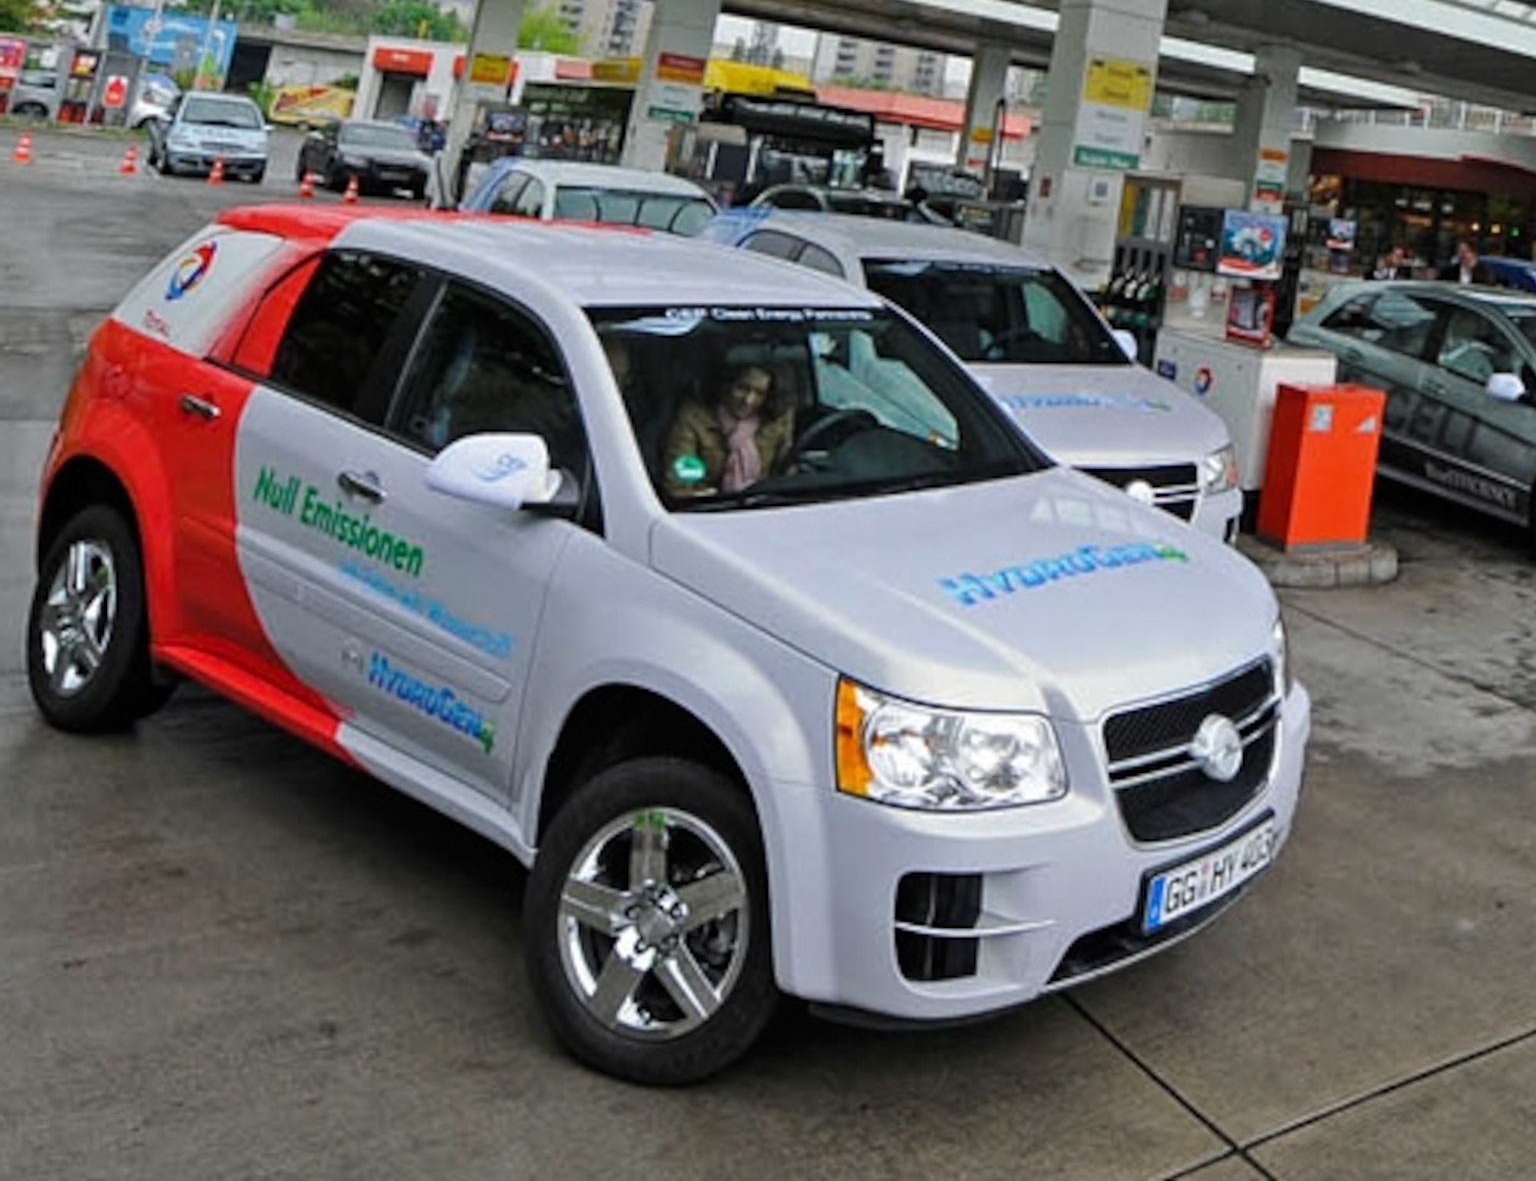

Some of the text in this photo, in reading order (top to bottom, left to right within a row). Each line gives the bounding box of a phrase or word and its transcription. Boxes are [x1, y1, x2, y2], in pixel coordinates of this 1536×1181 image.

[253, 467, 425, 578] Null Emissionen
[1166, 870, 1198, 913] GG
[1210, 852, 1238, 894] HY
